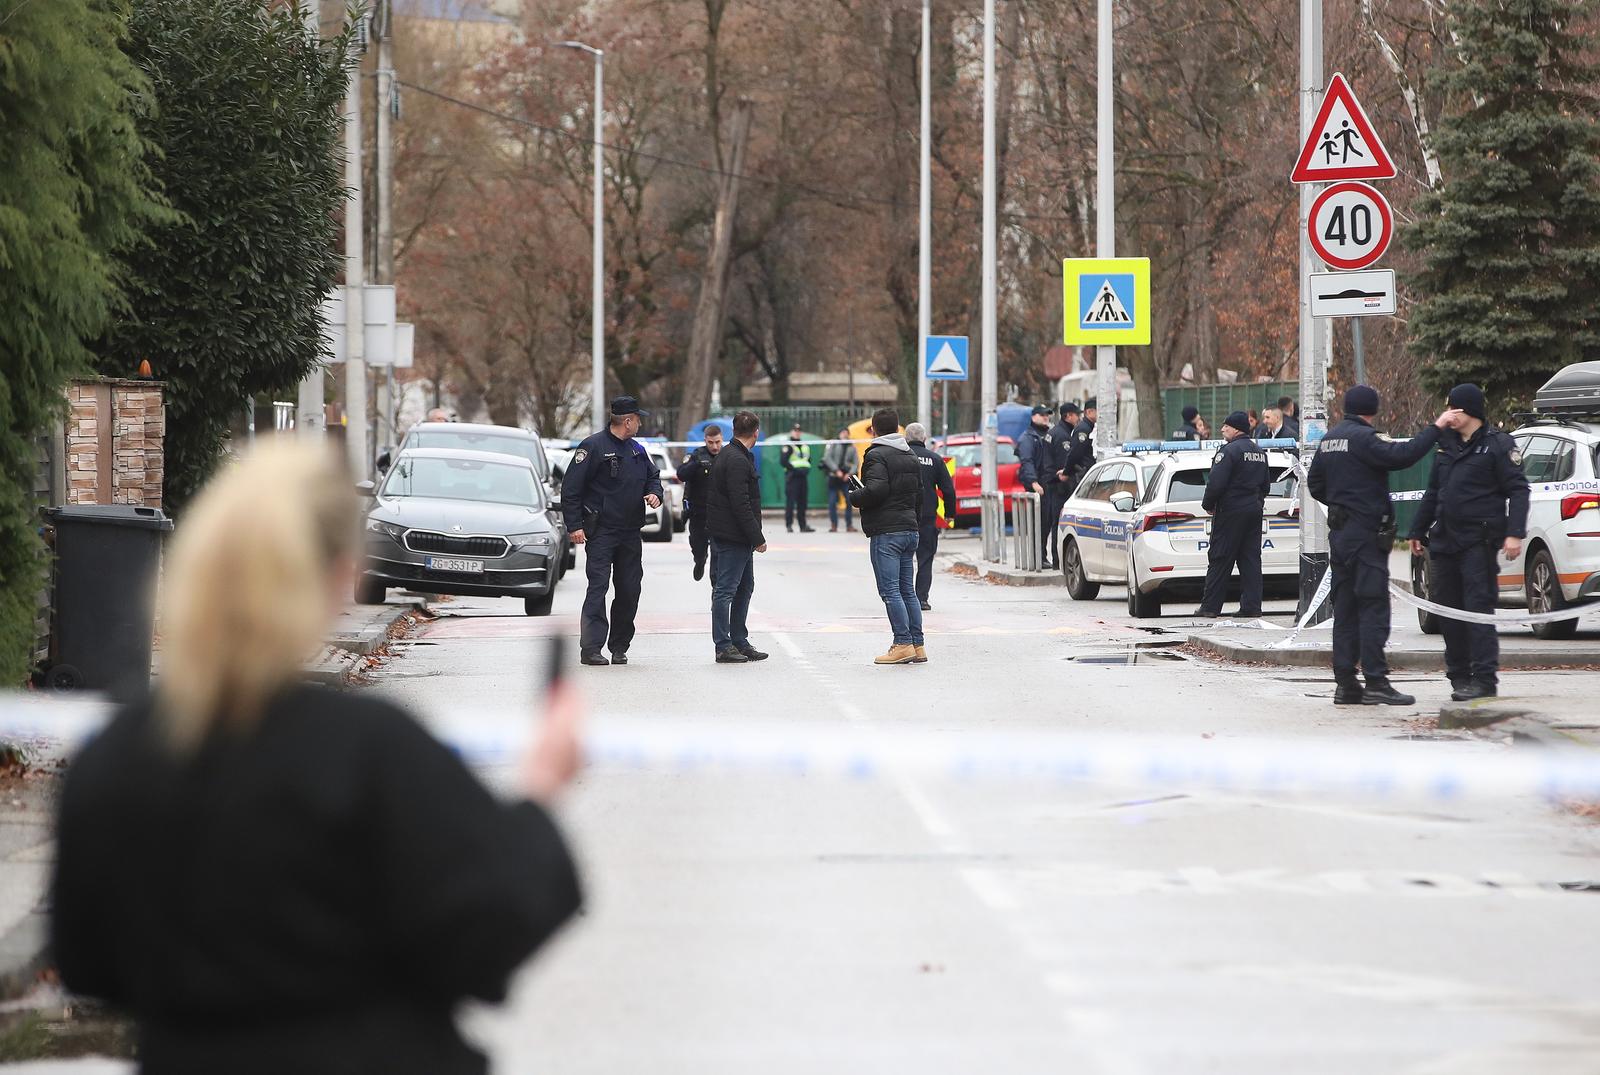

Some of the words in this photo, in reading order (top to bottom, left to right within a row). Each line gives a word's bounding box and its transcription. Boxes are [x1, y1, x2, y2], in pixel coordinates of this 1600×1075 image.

[1324, 203, 1372, 246] 40
[1554, 481, 1598, 491] POLICIJA
[432, 559, 443, 569] ZG
